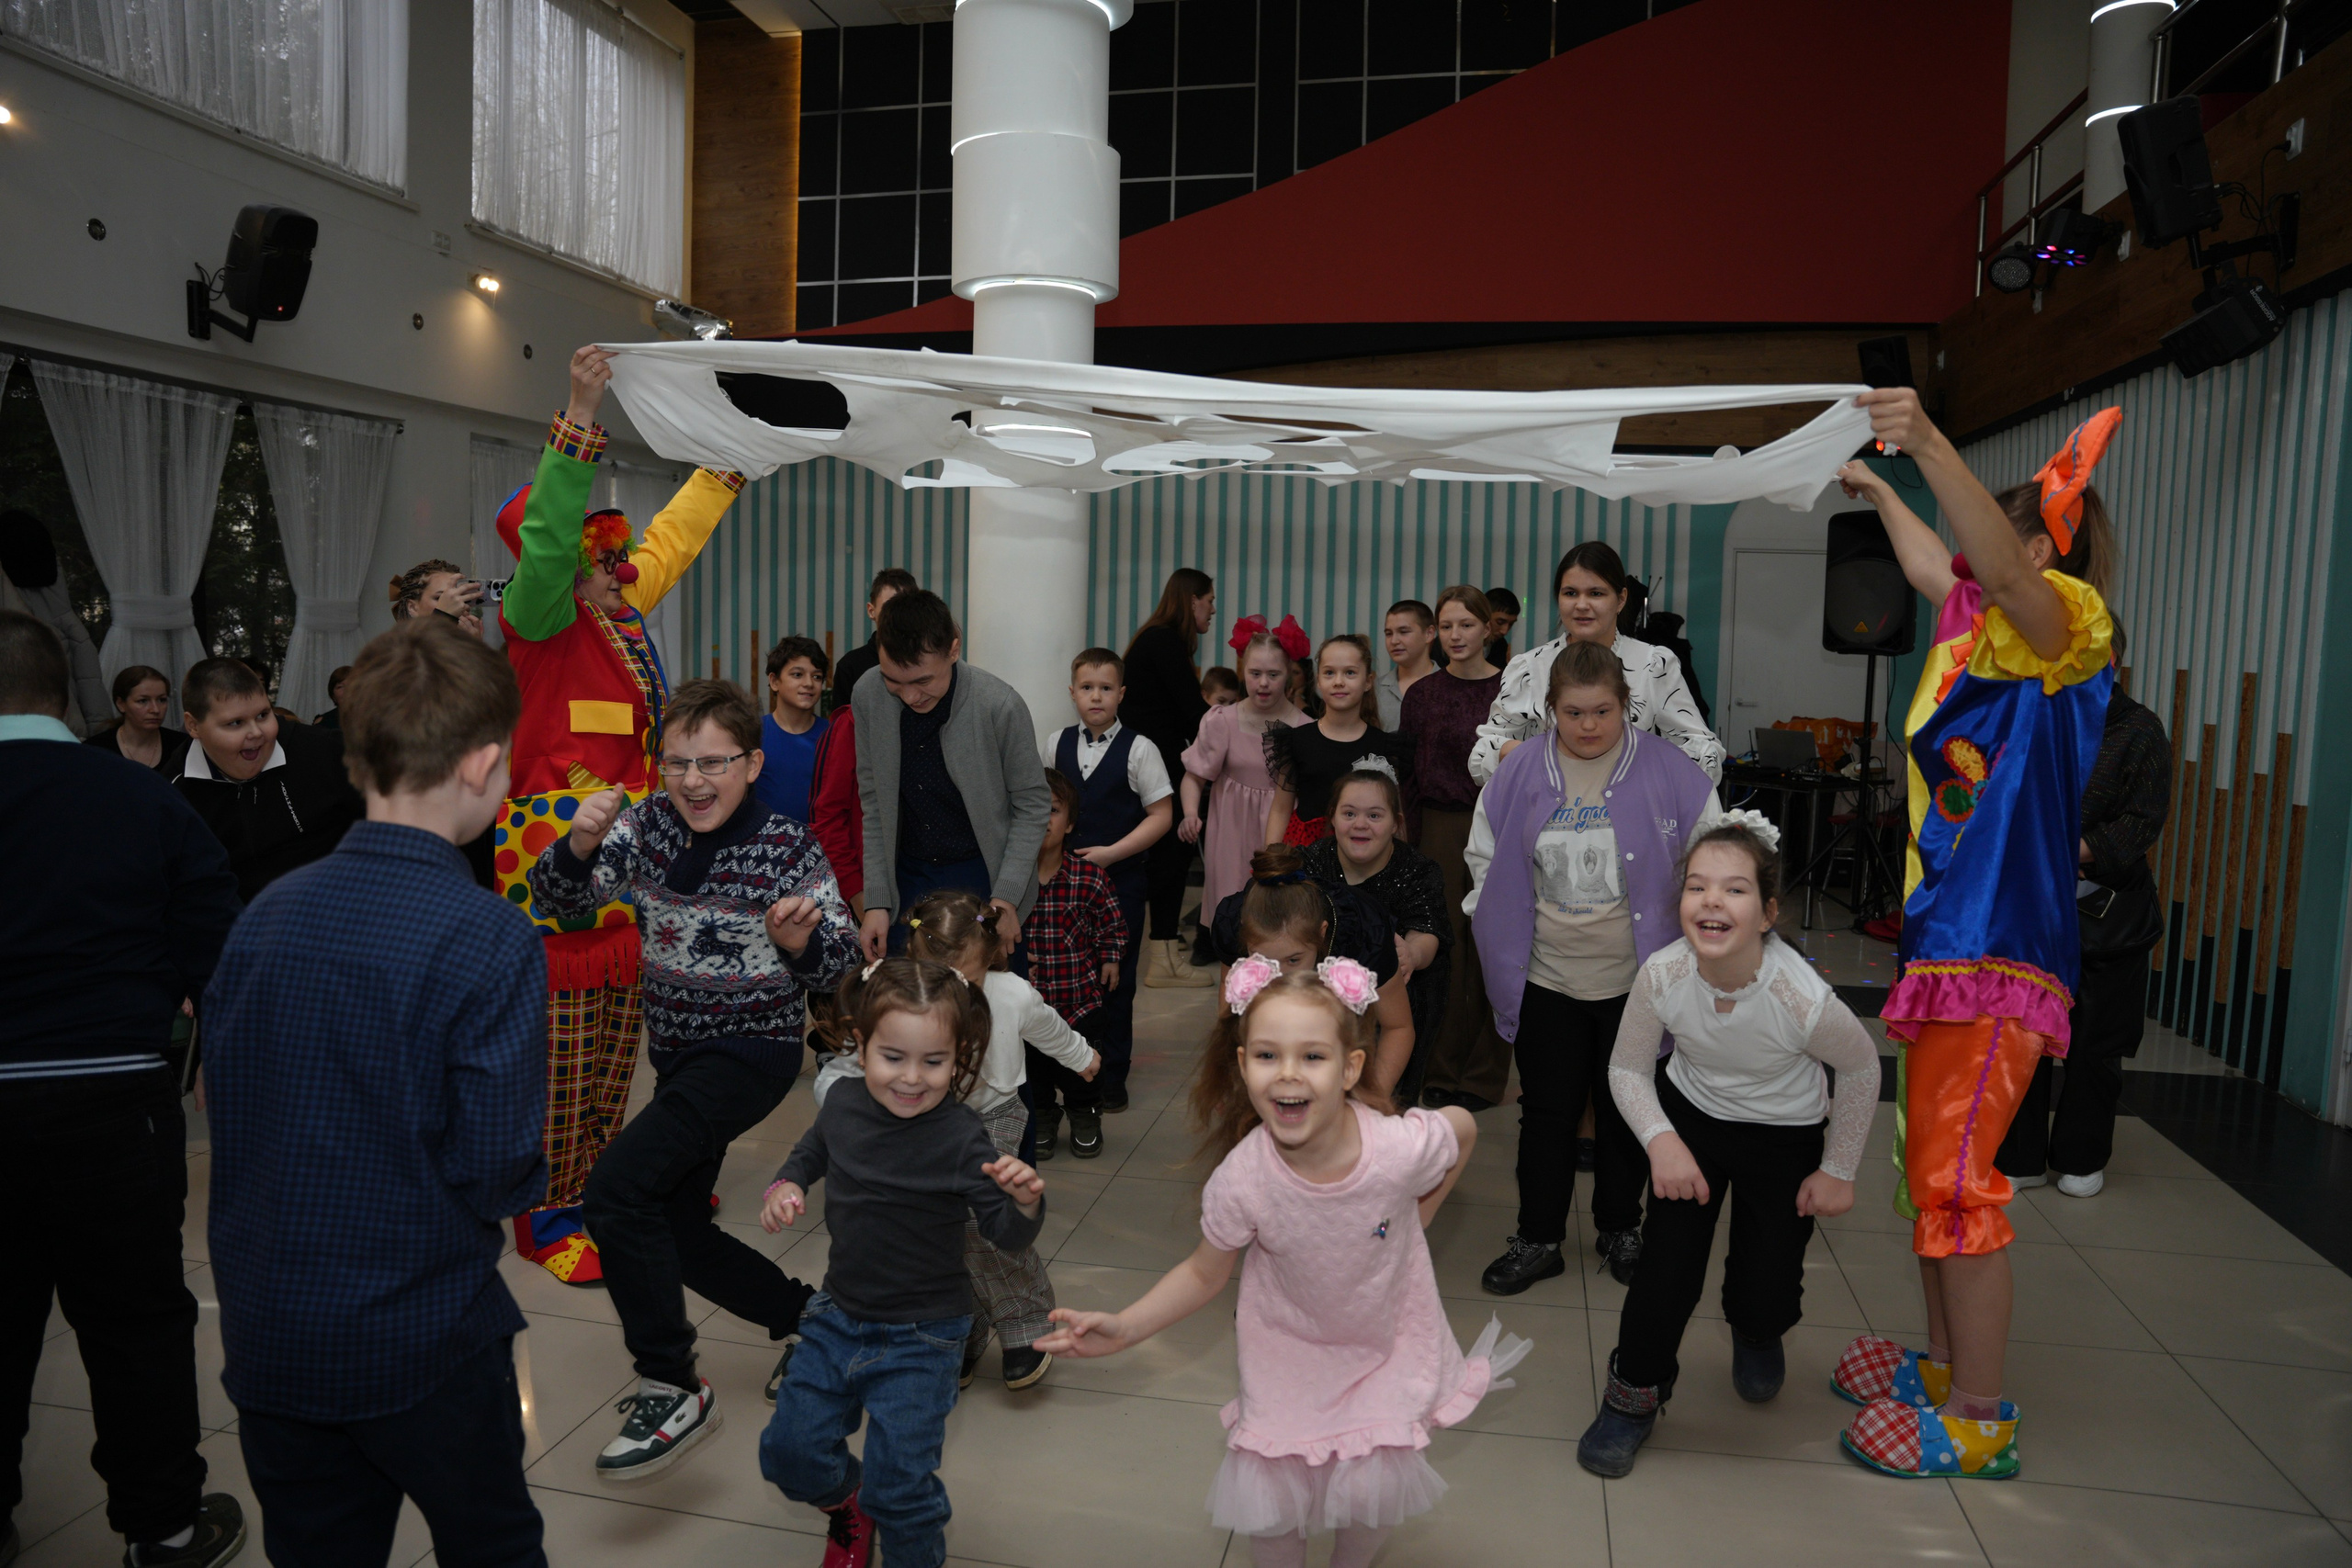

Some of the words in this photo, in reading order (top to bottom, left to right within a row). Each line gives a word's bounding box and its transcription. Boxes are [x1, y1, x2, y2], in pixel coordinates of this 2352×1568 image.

[1574, 805, 1611, 834] goo
[1572, 908, 1593, 916] should
[649, 1383, 673, 1393] LACOSTE
